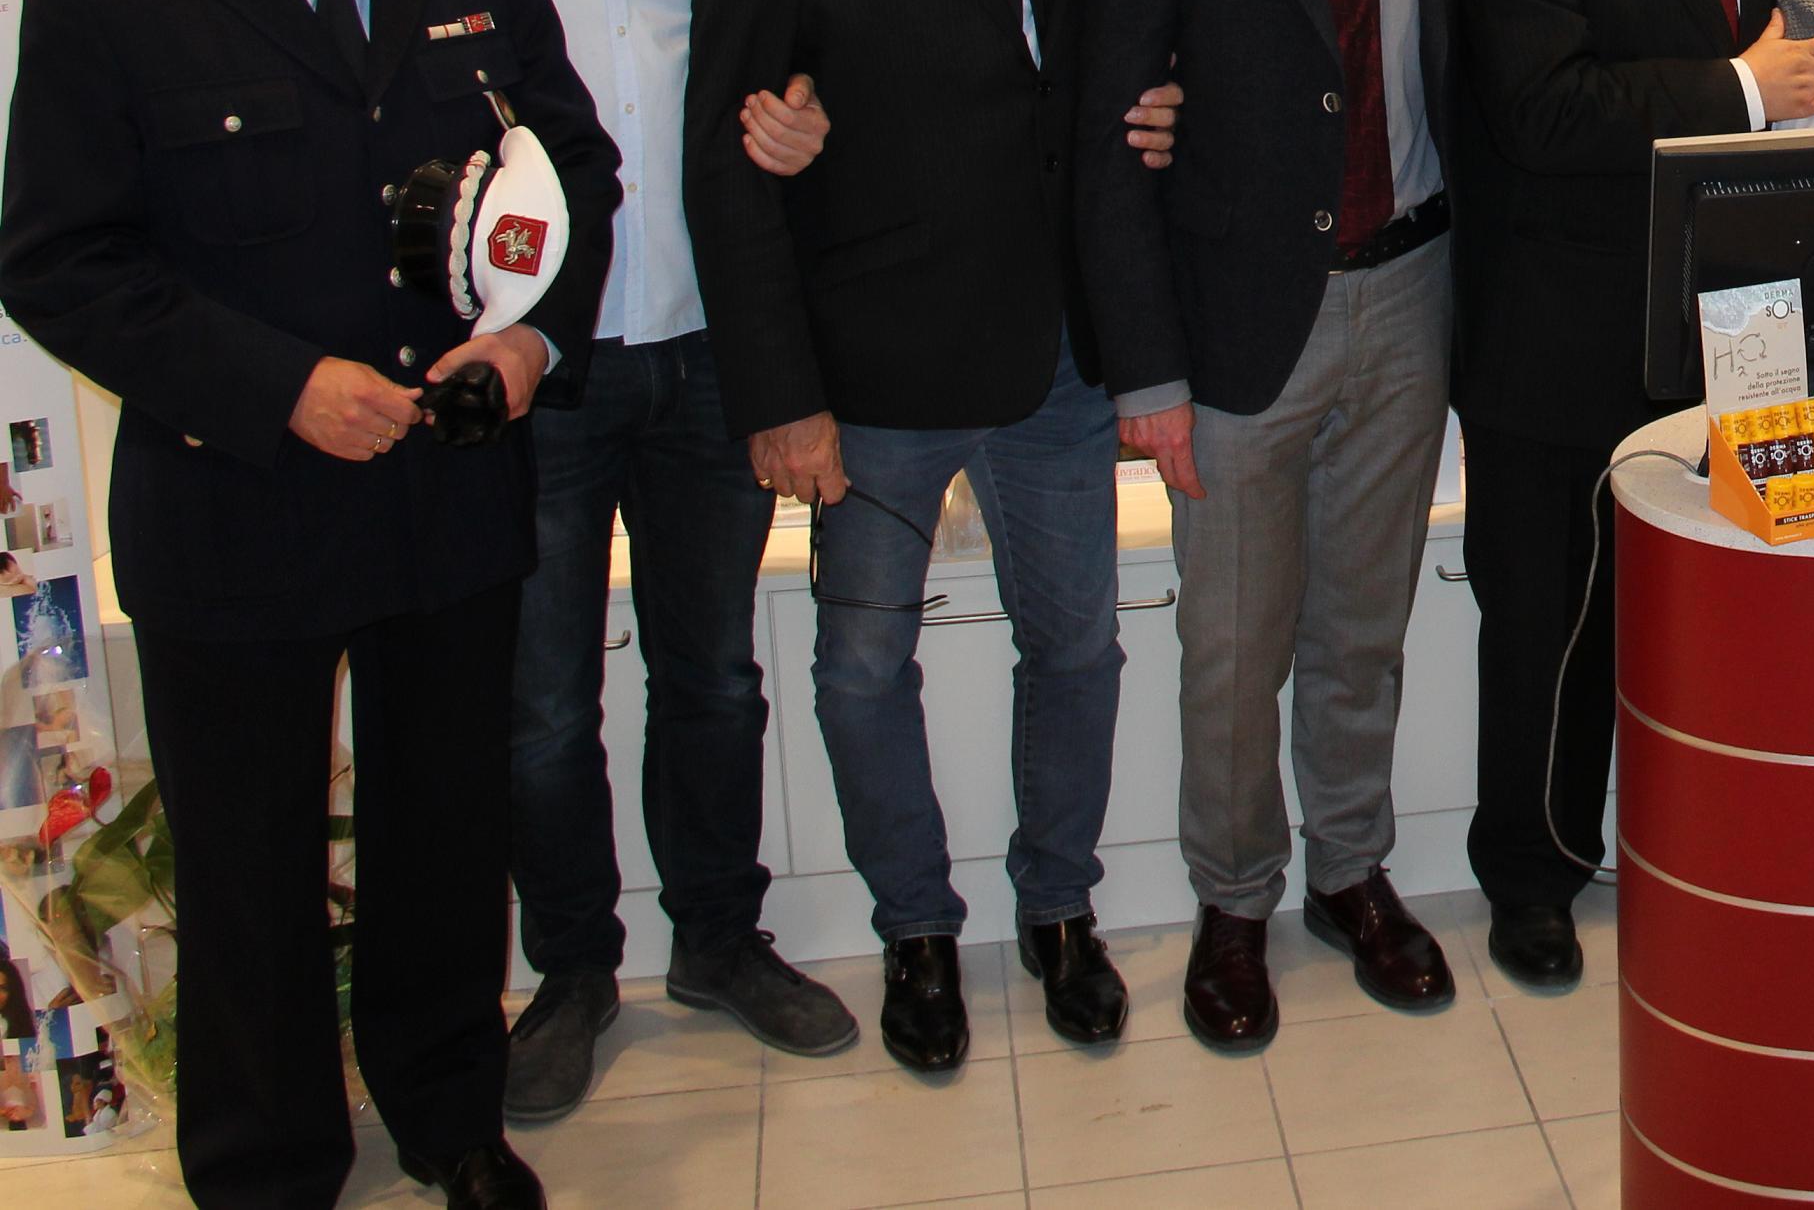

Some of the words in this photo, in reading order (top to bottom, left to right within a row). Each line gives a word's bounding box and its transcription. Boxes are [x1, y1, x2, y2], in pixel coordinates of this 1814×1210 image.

[1764, 289, 1794, 300] DERMA
[1765, 299, 1796, 319] SOL
[1756, 370, 1774, 380] Sotto
[1774, 369, 1780, 378] il
[1780, 367, 1800, 378] segno
[1747, 381, 1764, 391] della
[1765, 376, 1801, 389] protezione
[1738, 391, 1770, 402] resistente
[1783, 514, 1798, 524] STICK
